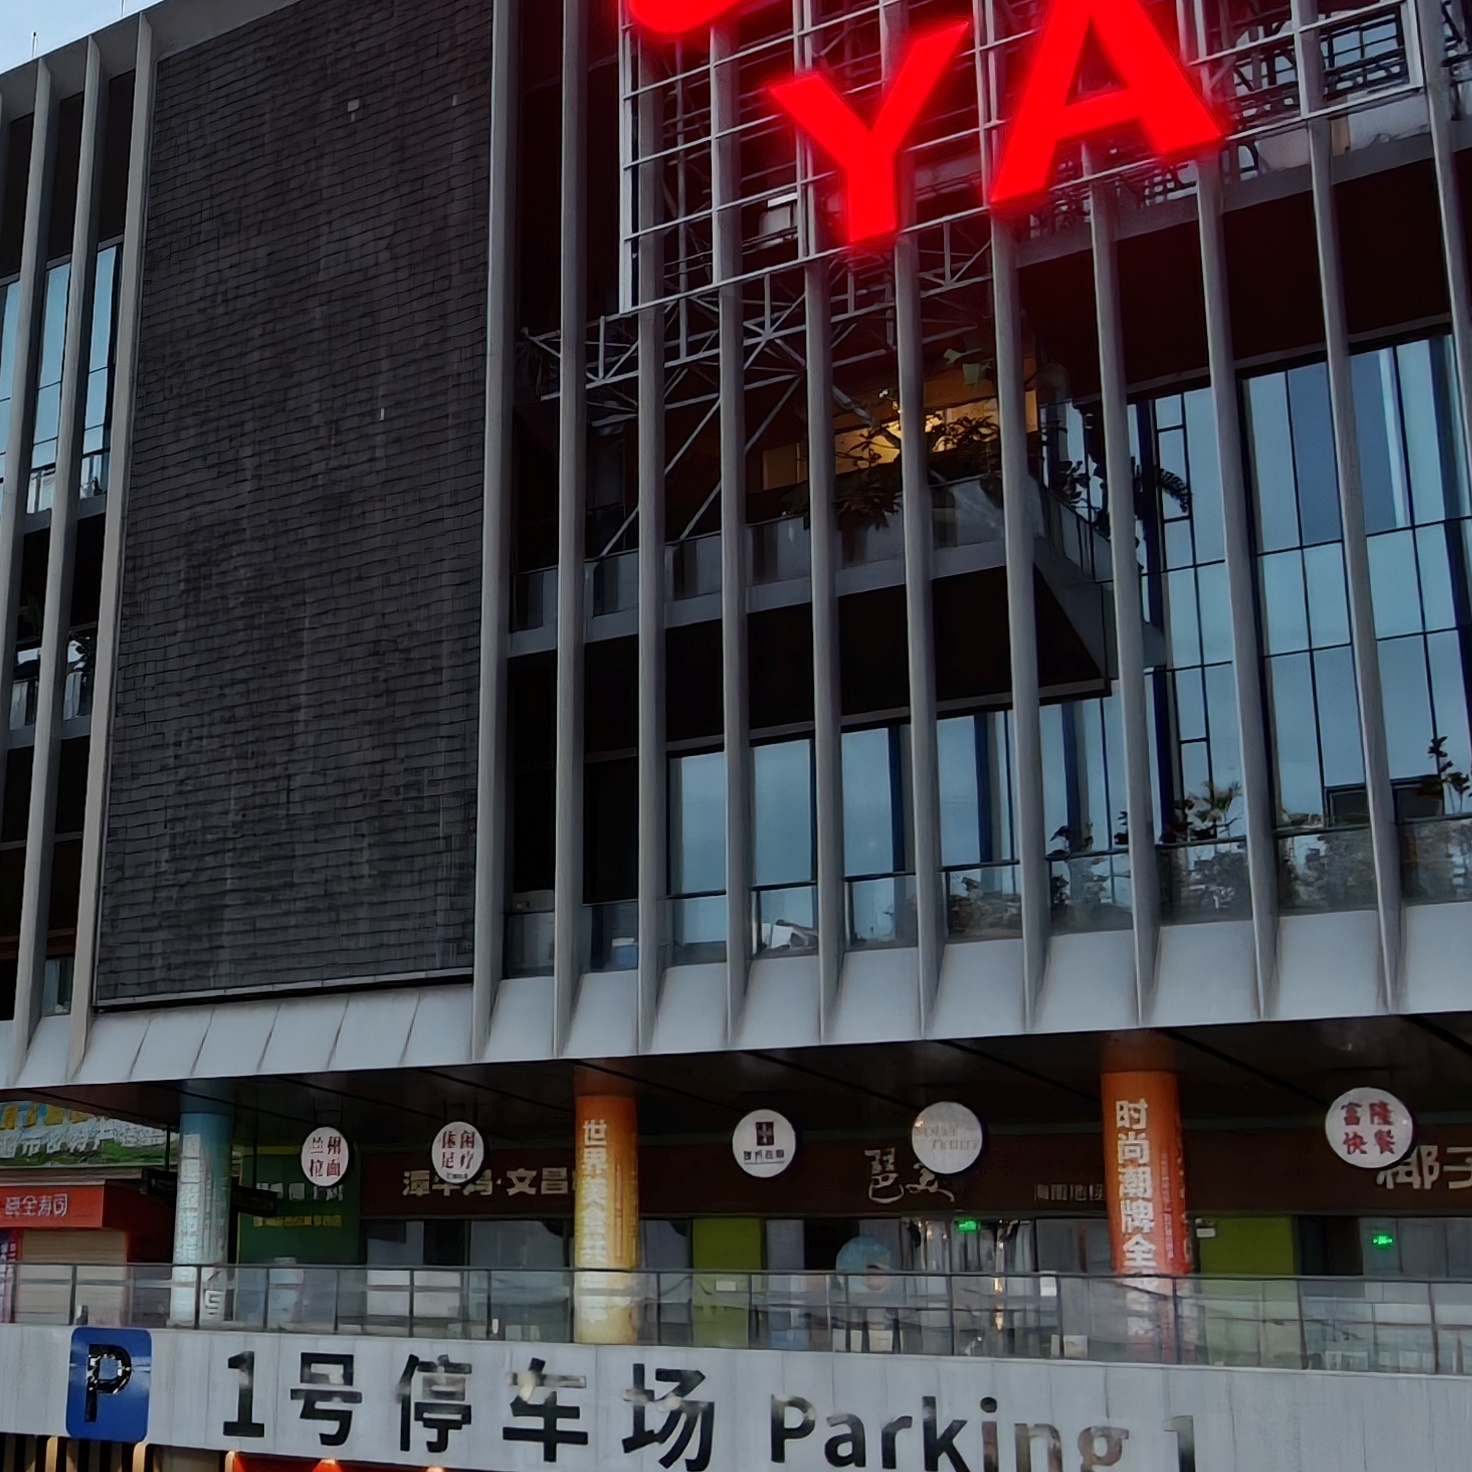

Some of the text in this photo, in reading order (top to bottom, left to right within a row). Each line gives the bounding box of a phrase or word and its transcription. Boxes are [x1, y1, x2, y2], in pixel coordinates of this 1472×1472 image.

[1115, 1099, 1157, 1337] 时尚潮牌全
[85, 1343, 134, 1423] P
